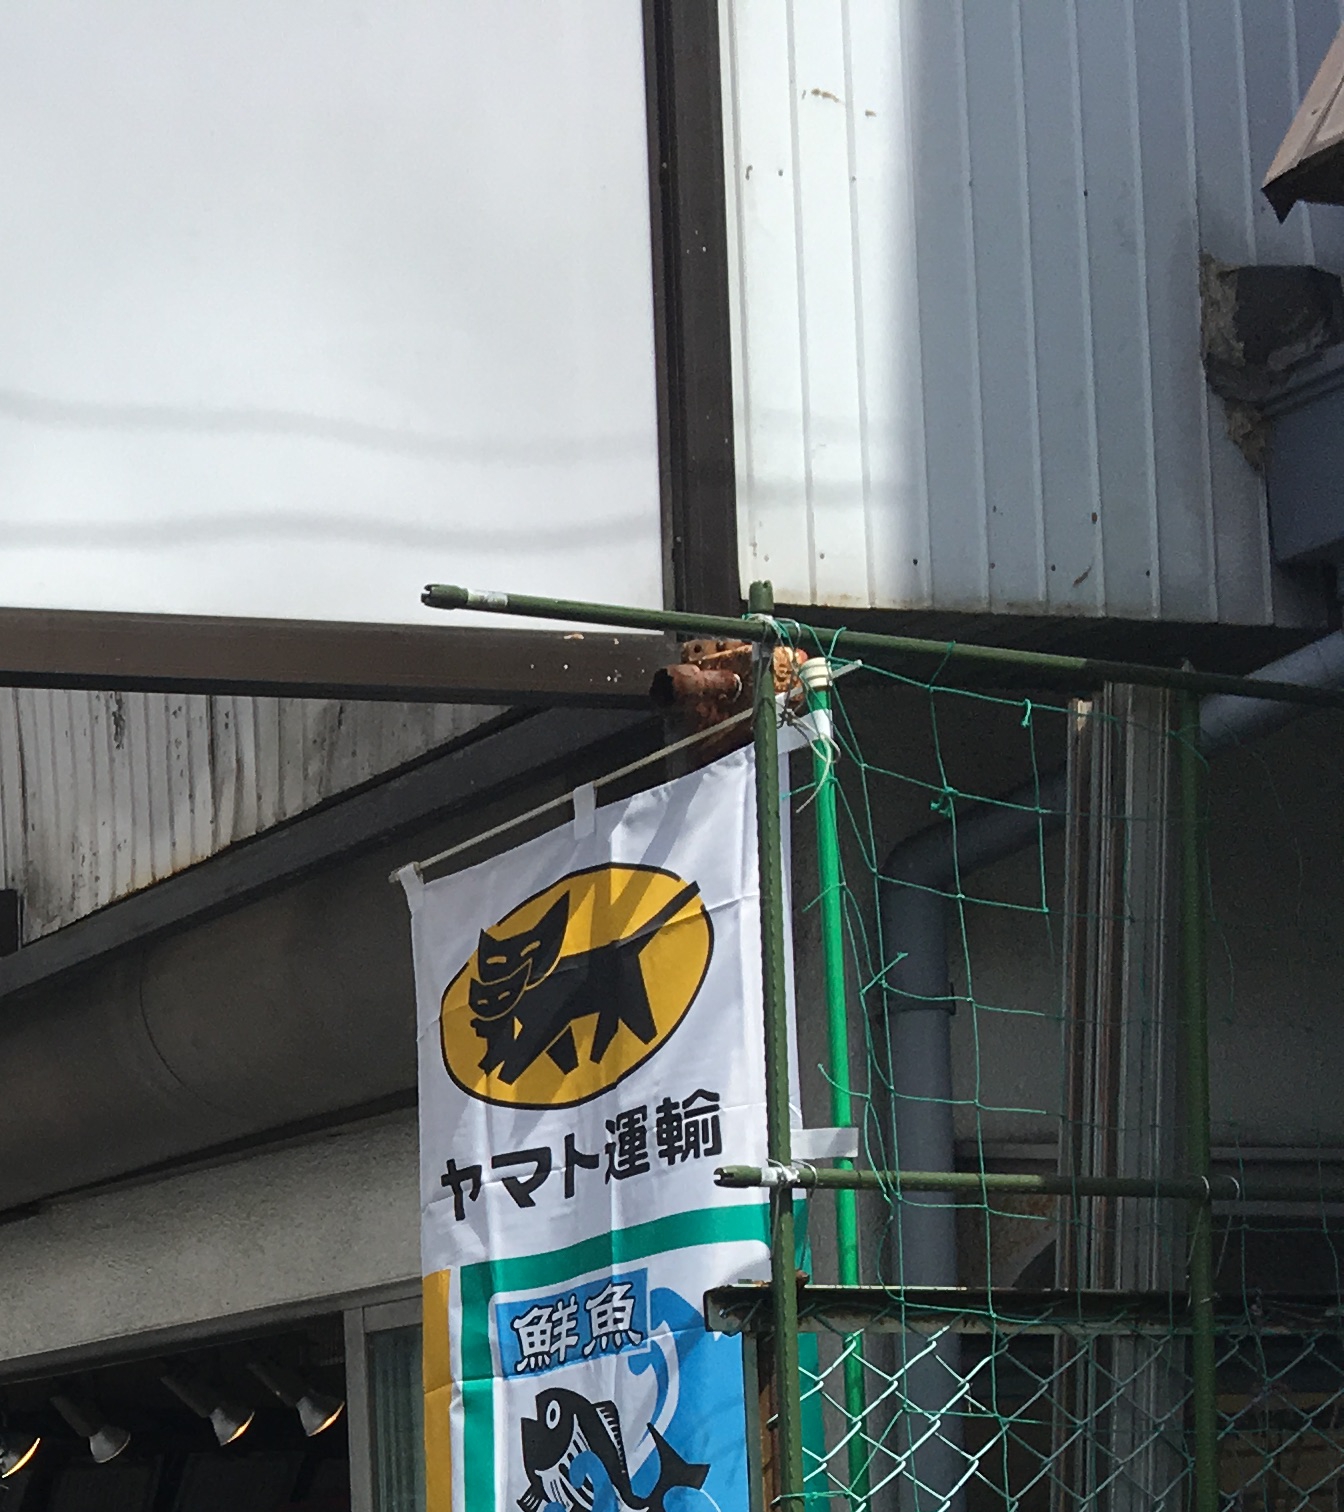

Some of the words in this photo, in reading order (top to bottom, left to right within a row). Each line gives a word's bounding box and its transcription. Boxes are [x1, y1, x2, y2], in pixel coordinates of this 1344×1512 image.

[440, 1089, 723, 1222] ヤマト運輸
[511, 1283, 642, 1374] 鮮魚
